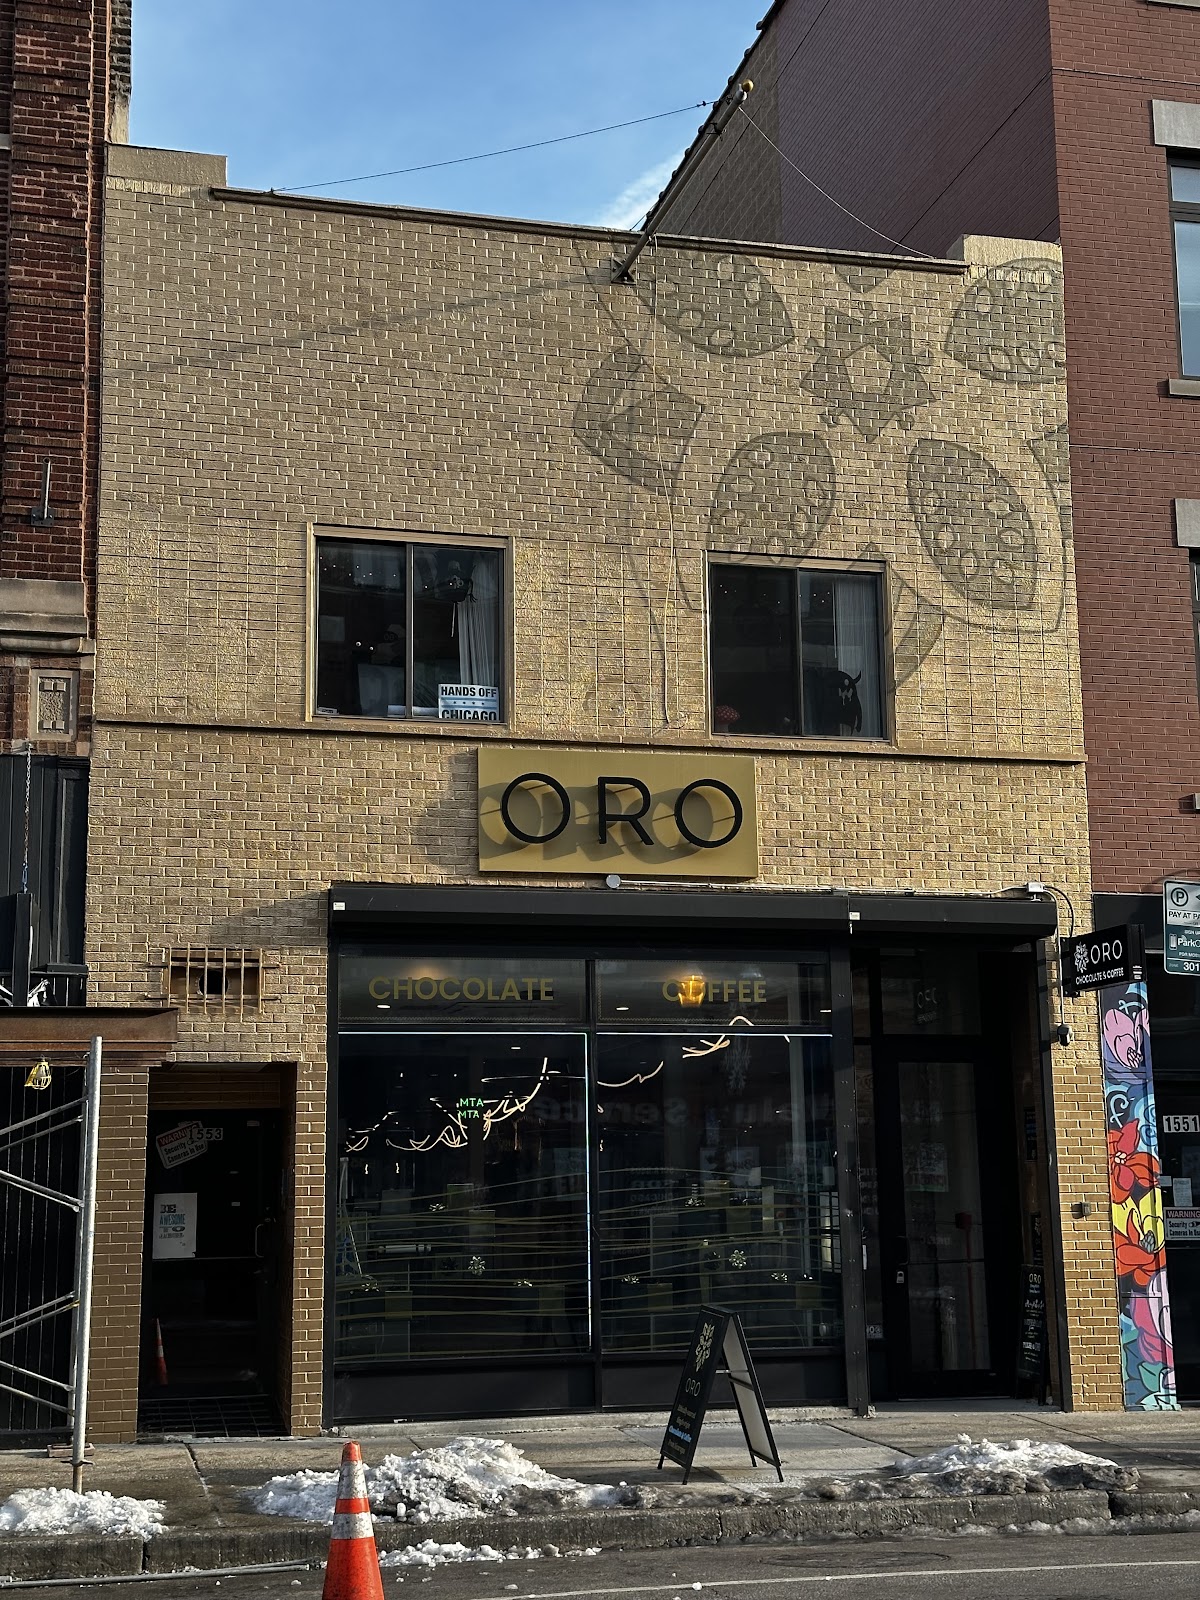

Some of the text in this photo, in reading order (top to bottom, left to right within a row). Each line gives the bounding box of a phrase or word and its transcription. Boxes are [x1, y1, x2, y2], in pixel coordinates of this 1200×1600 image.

[441, 686, 497, 698] HANDS OFF
[441, 709, 497, 721] CHICAGO
[501, 772, 743, 848] ORO
[1090, 940, 1122, 964] ORO
[1076, 972, 1102, 985] CHOCOLATE
[1107, 967, 1124, 978] COFFEE
[368, 976, 554, 1001] CHOCOLATE
[459, 1097, 484, 1108] MTA
[458, 1109, 480, 1119] MTA
[1164, 1116, 1199, 1132] 1551
[189, 1129, 222, 1140] 1553
[163, 1141, 188, 1156] Security
[167, 1150, 190, 1164] Cameras
[194, 1143, 205, 1152] Use
[160, 1204, 176, 1213] BE
[1167, 1210, 1200, 1219] WARNING
[159, 1213, 186, 1226] AWESOME
[1168, 1220, 1188, 1230] Security
[1169, 1229, 1189, 1237] Cameras
[686, 1377, 700, 1396] ORO
